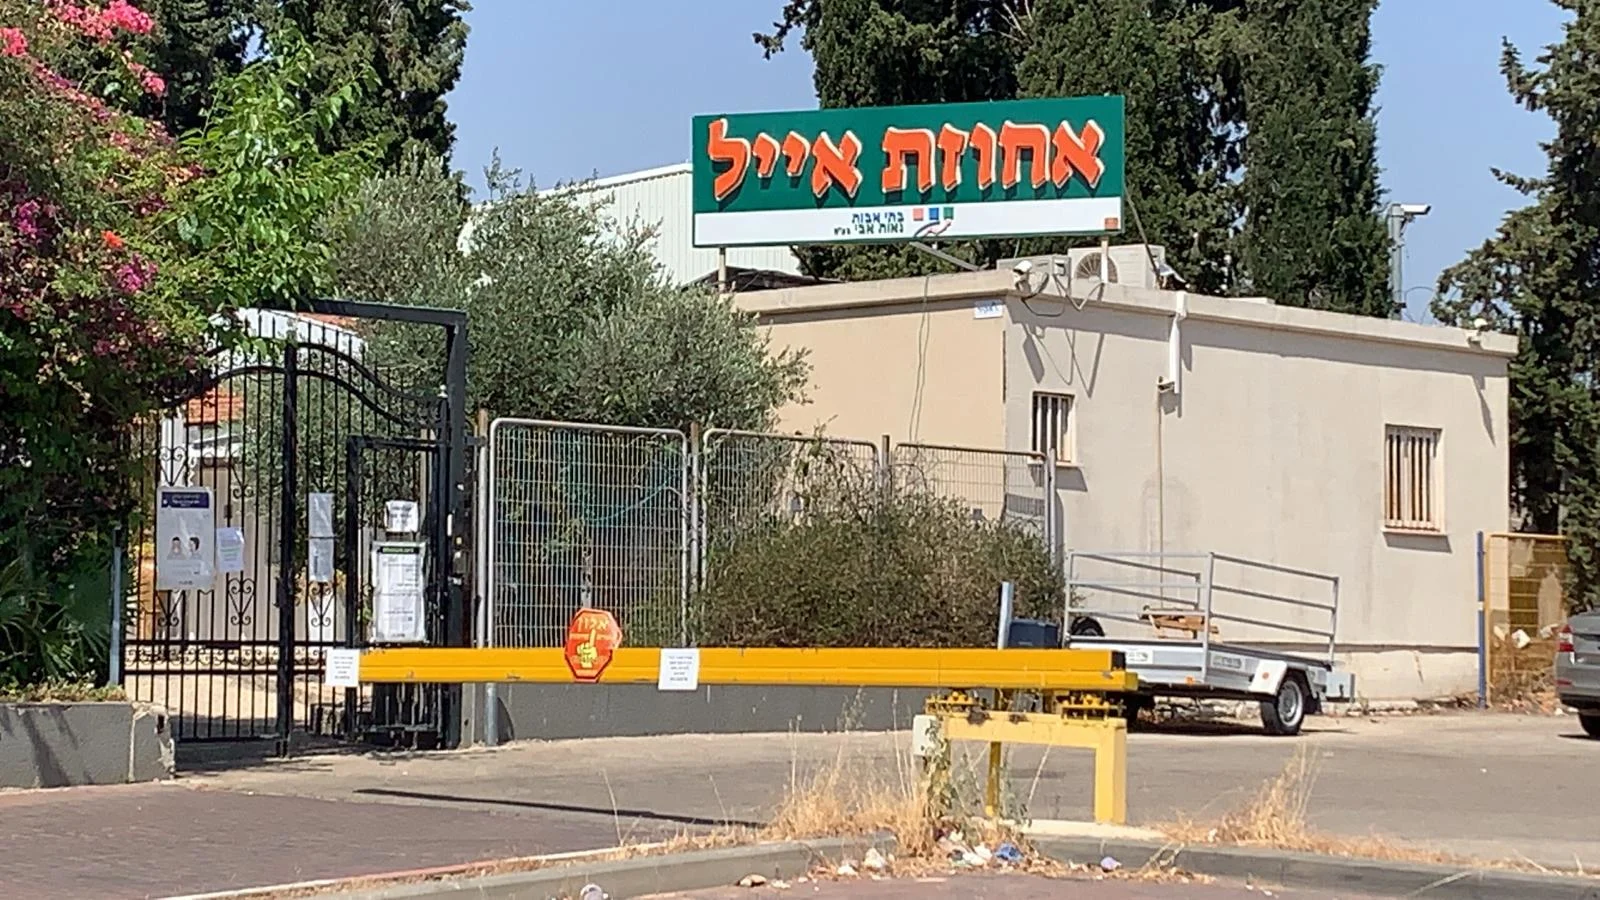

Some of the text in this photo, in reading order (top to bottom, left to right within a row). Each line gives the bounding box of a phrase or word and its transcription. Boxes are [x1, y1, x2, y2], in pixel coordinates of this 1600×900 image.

[707, 117, 1105, 201] אחוזת אייל
[852, 211, 904, 224] בתי אבות
[855, 223, 874, 235] אבי
[878, 222, 904, 234] נאות
